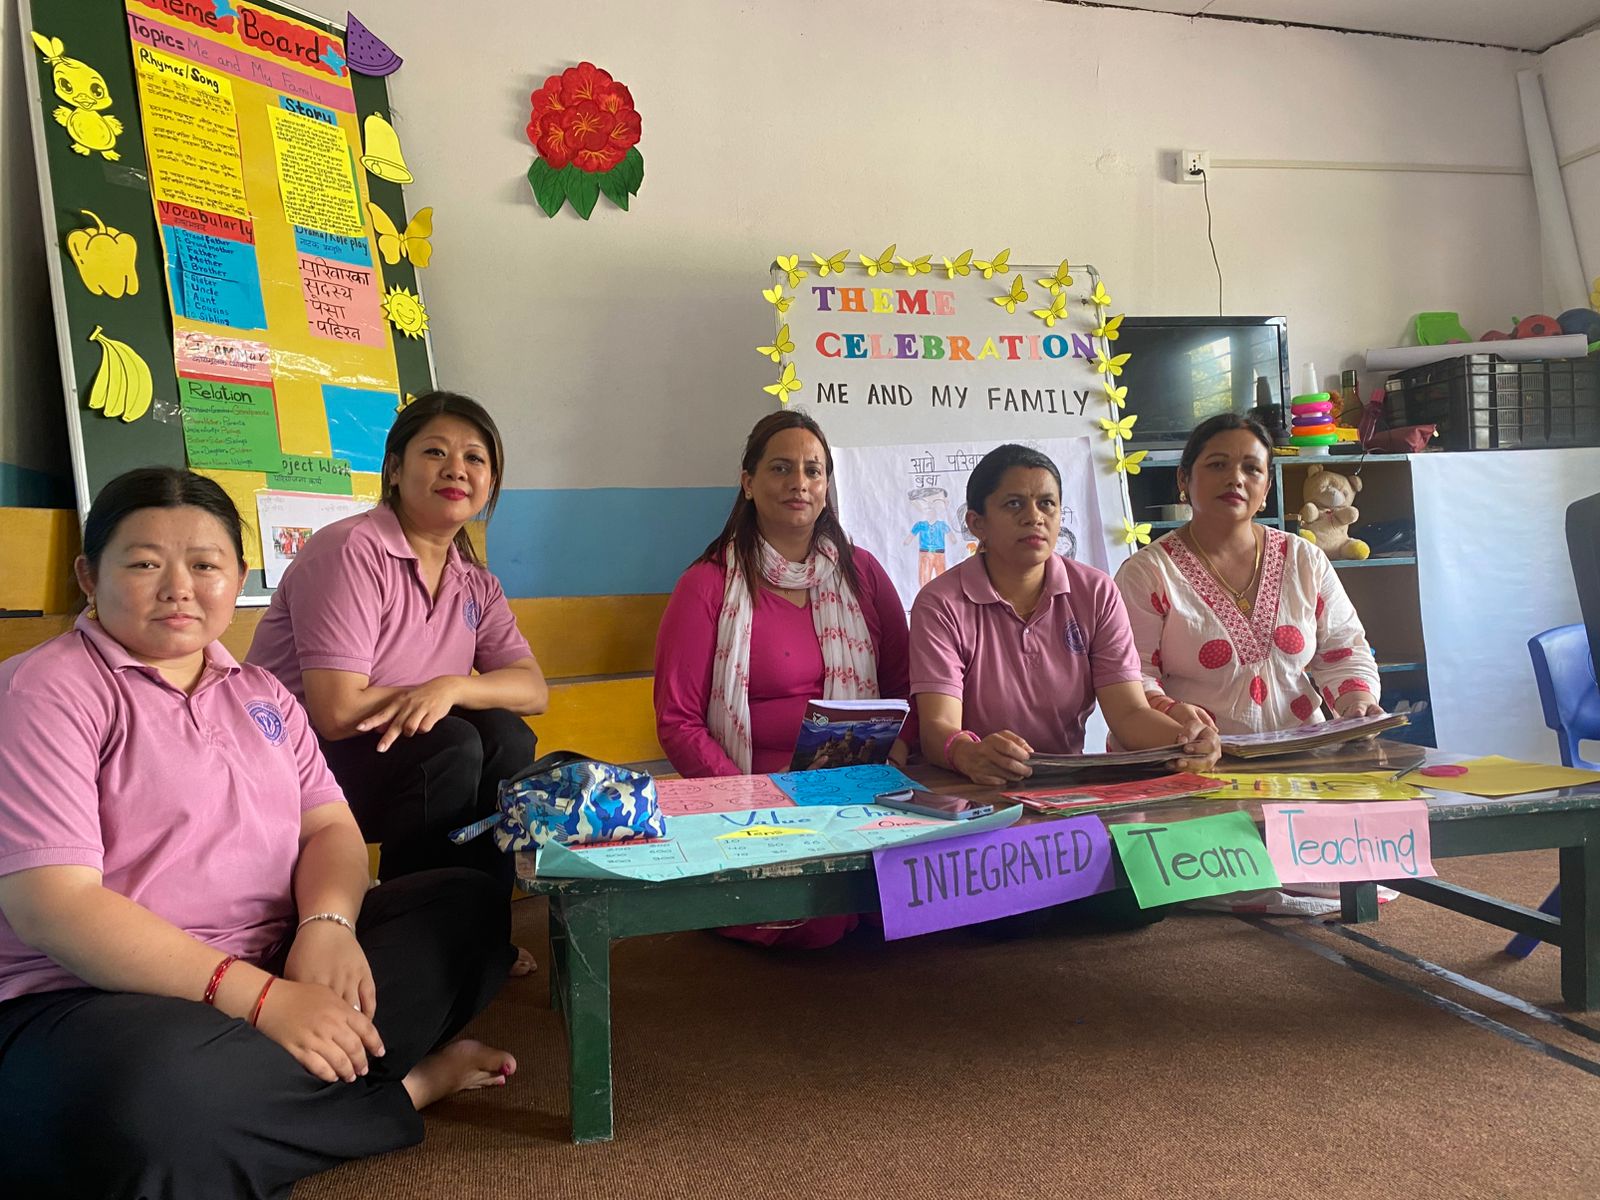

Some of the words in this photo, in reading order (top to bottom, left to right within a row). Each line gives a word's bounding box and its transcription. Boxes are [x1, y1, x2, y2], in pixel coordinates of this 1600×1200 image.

[241, 8, 320, 64] Board
[187, 37, 209, 59] Me
[217, 54, 241, 73] and
[251, 61, 273, 88] My
[281, 71, 322, 104] Family
[285, 97, 333, 126] Story
[350, 237, 369, 257] play
[811, 286, 956, 316] THEME
[815, 331, 1099, 361] CELEBRATION
[188, 381, 253, 404] Relation
[817, 382, 849, 405] ME
[867, 383, 913, 406] AND
[931, 385, 968, 409] MY
[987, 387, 1090, 417] FAMILY
[319, 459, 352, 478] Work
[719, 810, 812, 827] Value
[836, 805, 909, 819] Char
[739, 829, 784, 837] Tens
[1278, 809, 1419, 876] Teaching
[903, 829, 1093, 908] INTEGRATED
[1127, 826, 1260, 887] Team
